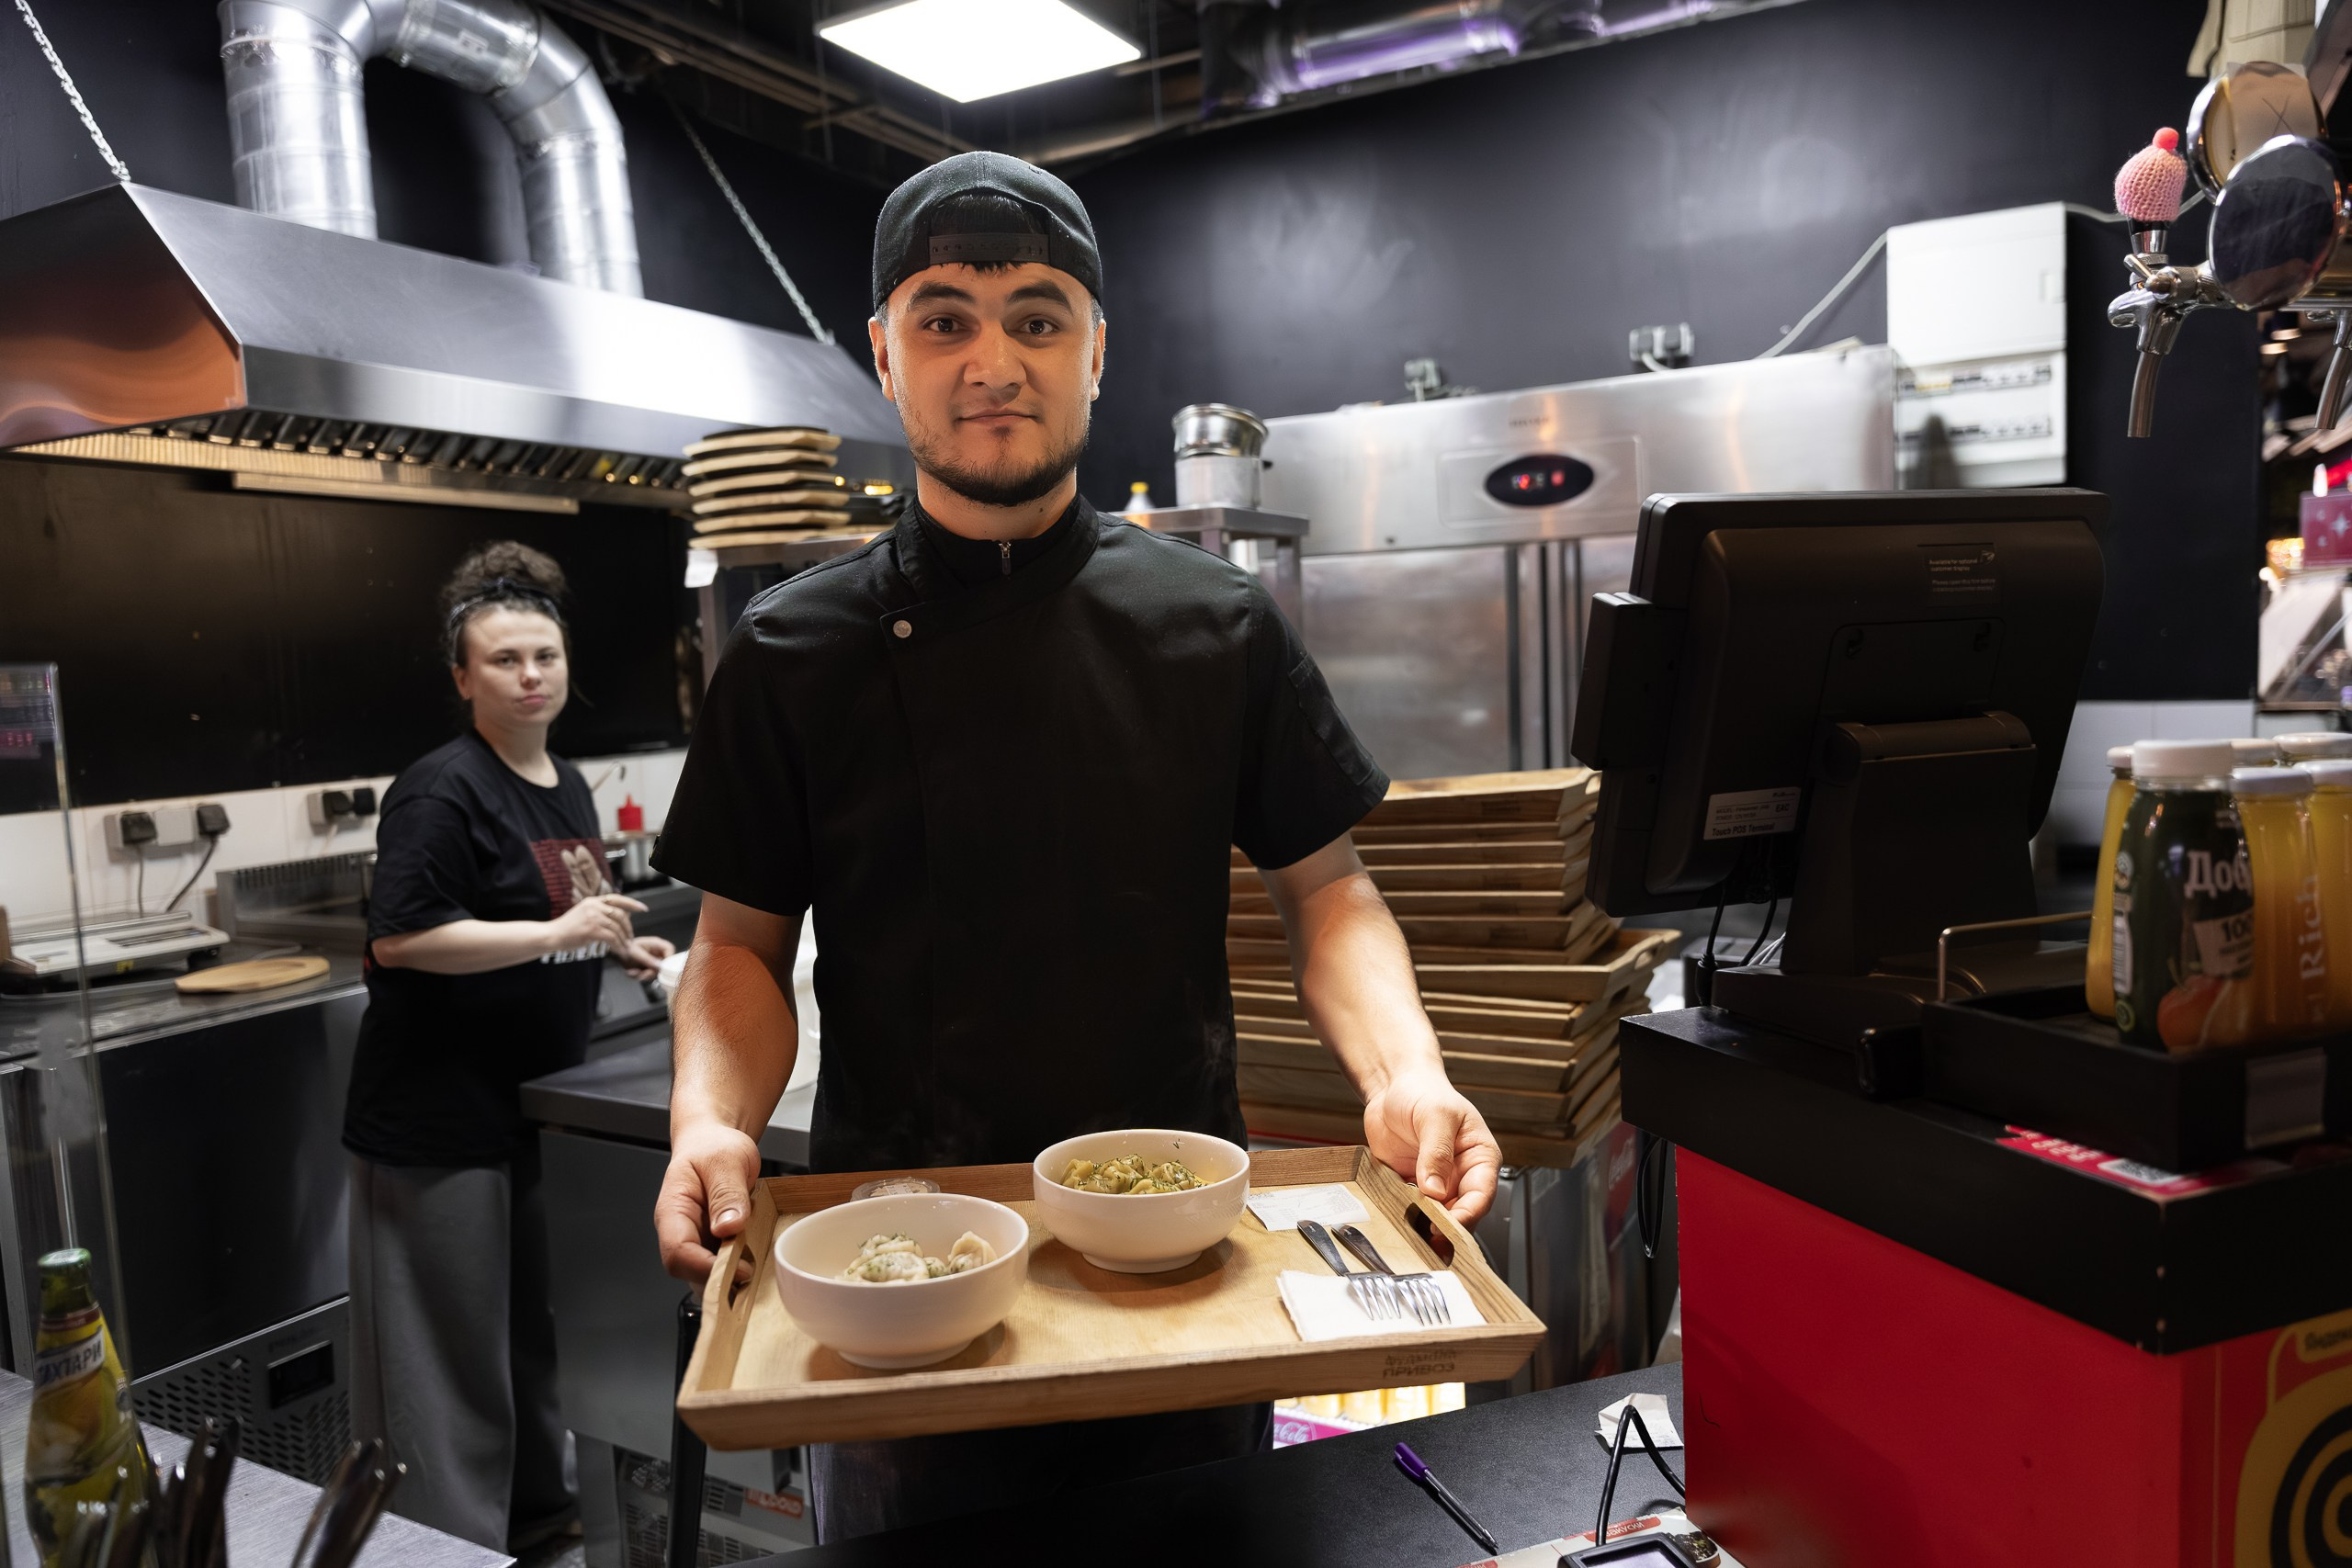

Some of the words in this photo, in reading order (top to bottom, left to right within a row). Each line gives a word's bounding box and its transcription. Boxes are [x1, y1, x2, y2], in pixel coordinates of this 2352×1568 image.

[1712, 828, 1731, 837] Touch
[1732, 825, 1747, 835] POS
[2297, 874, 2325, 980] Rich
[1383, 1361, 1456, 1379] ПРИВОЗ
